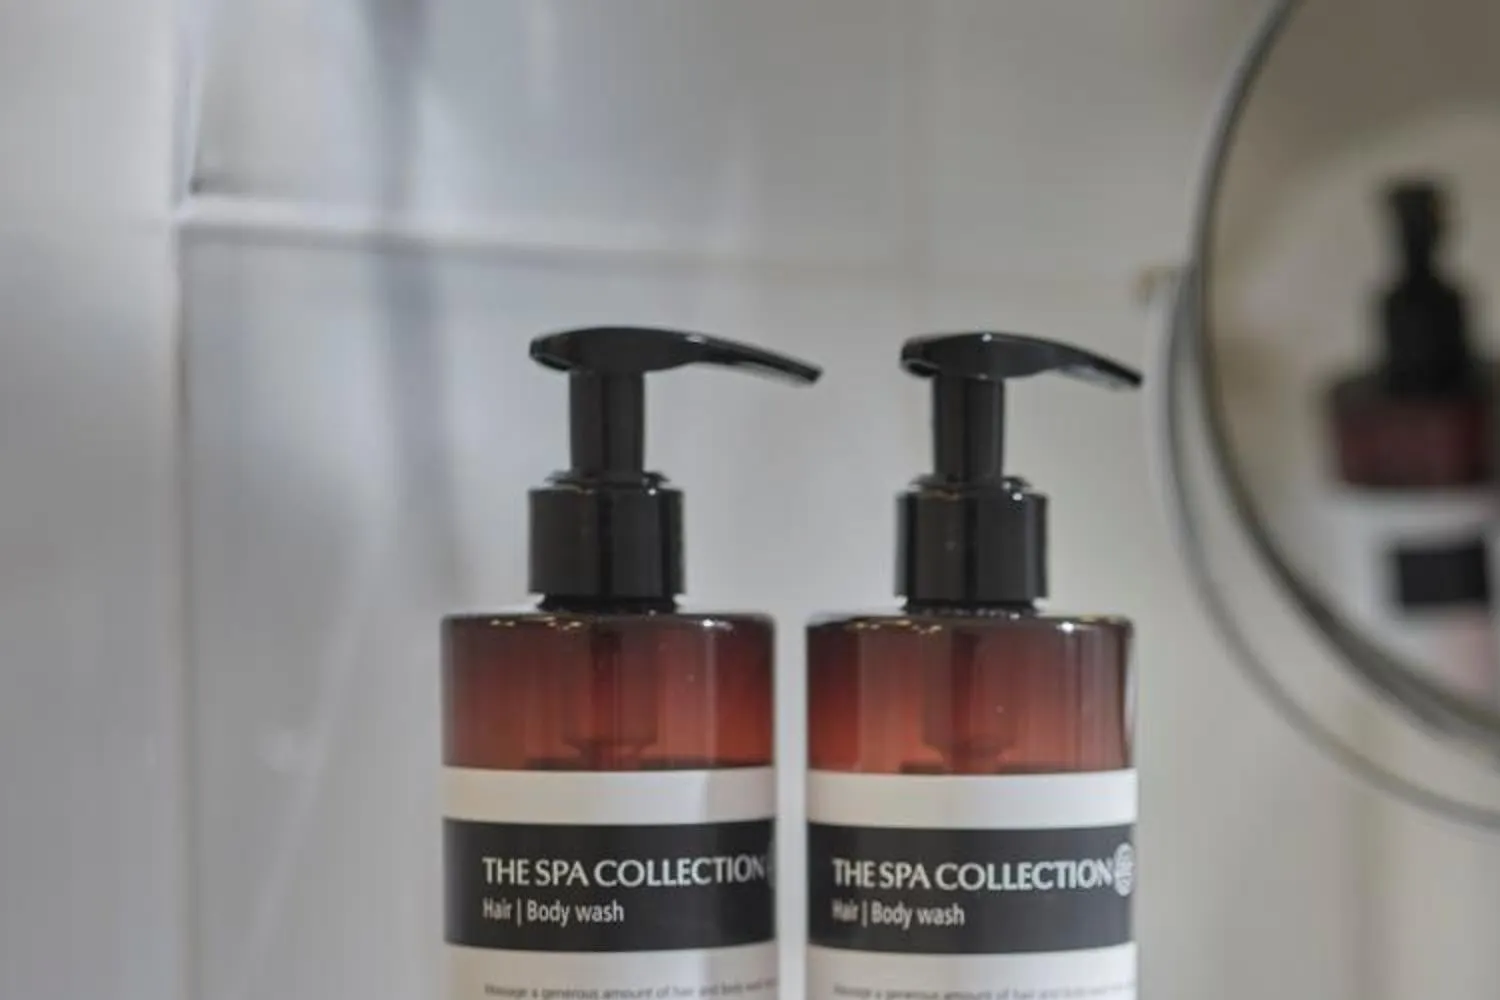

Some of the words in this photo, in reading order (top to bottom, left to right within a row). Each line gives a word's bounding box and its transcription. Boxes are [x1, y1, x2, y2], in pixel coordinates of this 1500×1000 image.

[482, 857, 530, 886] THE
[535, 858, 590, 887] SPA
[594, 854, 766, 888] COLLECTION
[832, 857, 877, 887] THE
[879, 860, 932, 890] SPA
[935, 857, 1114, 891] COLLECTION
[483, 896, 512, 921] Hair
[527, 899, 570, 928] Body
[574, 899, 624, 923] wash
[832, 898, 859, 922] Hair
[871, 899, 913, 929] Body
[917, 902, 965, 926] wash
